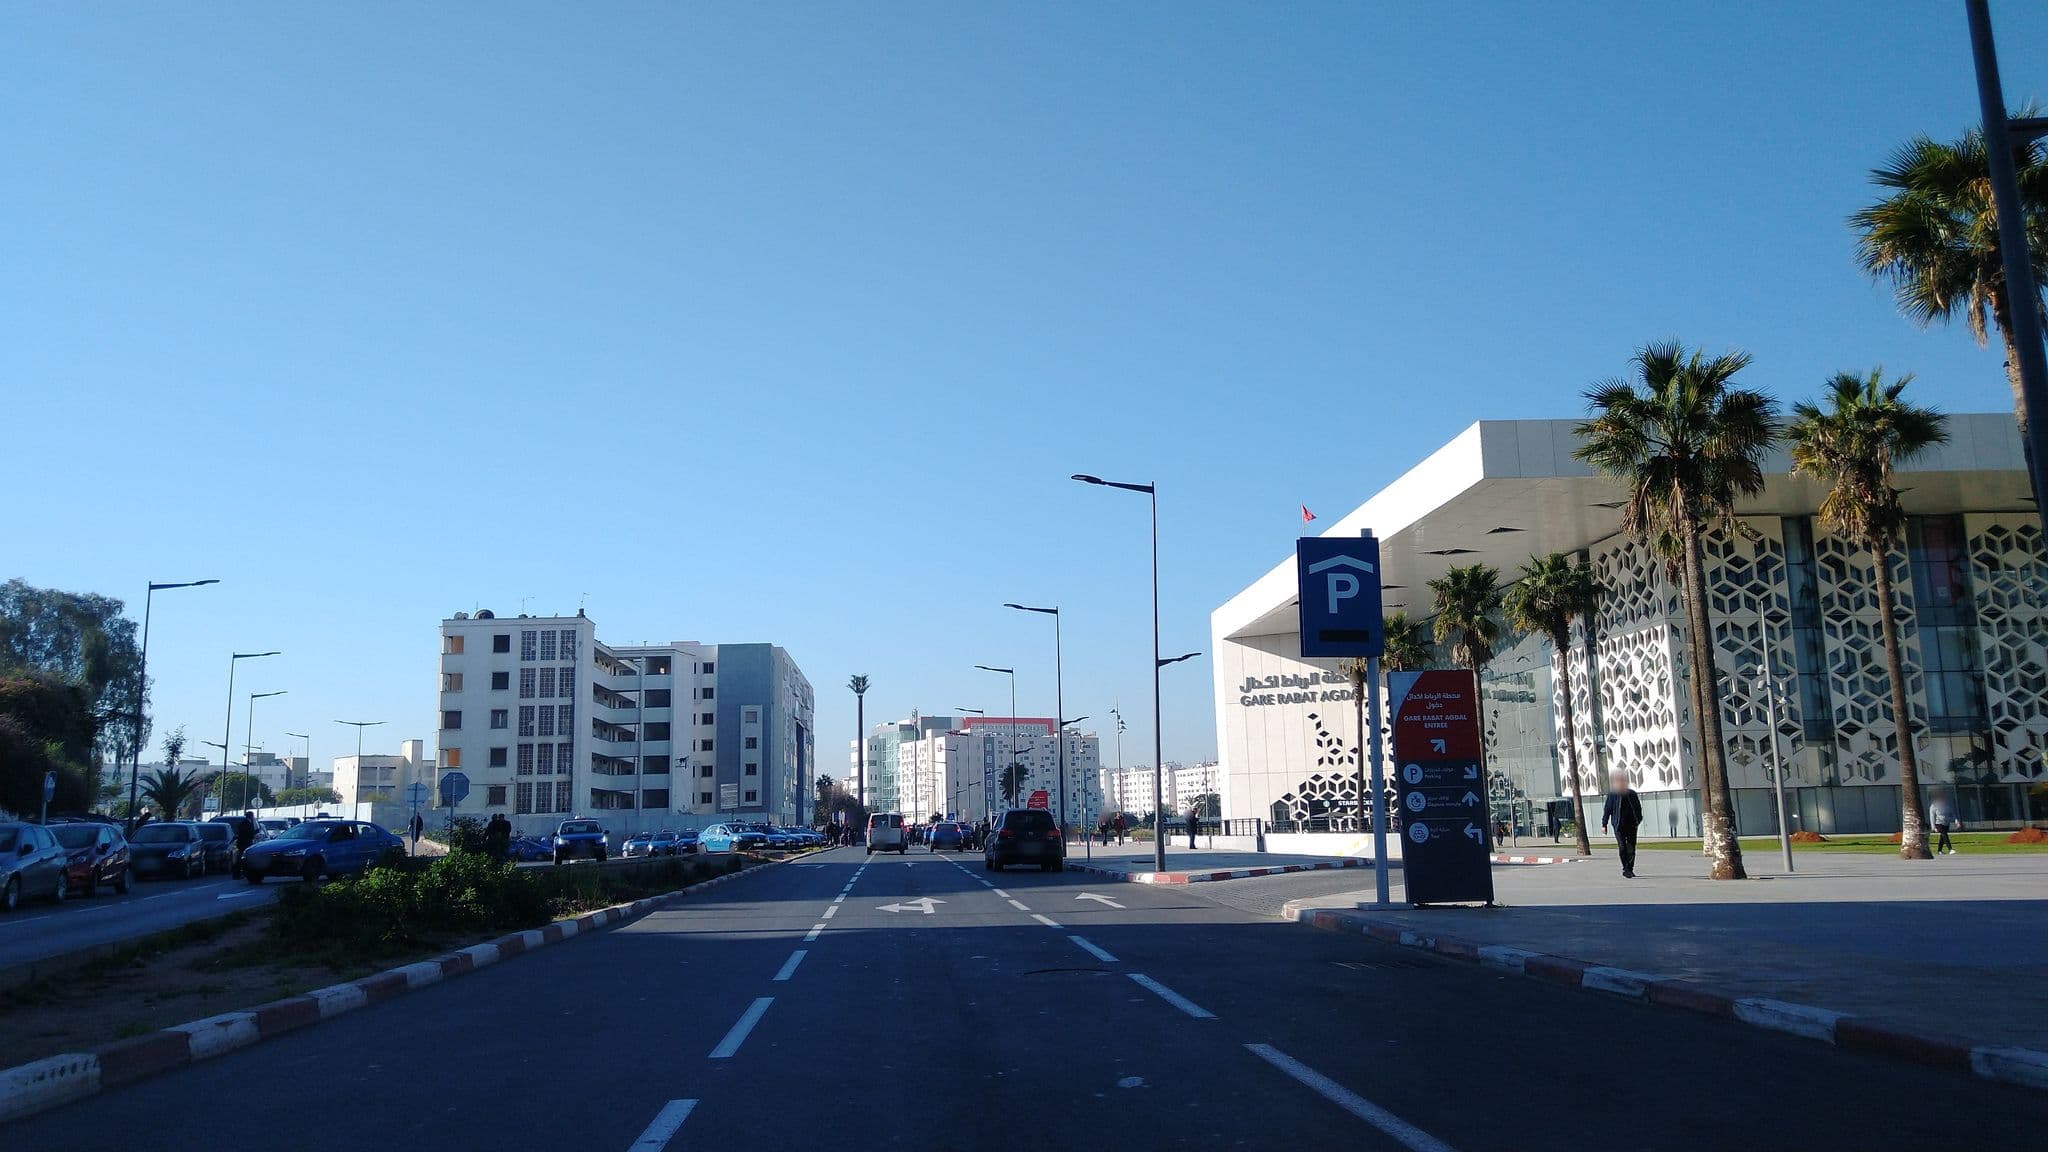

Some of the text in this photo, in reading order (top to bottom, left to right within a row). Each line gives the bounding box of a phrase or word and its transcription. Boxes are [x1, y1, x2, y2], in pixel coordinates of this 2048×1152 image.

[1328, 573, 1359, 613] P
[1240, 689, 1356, 707] GARE RABAT AGD
